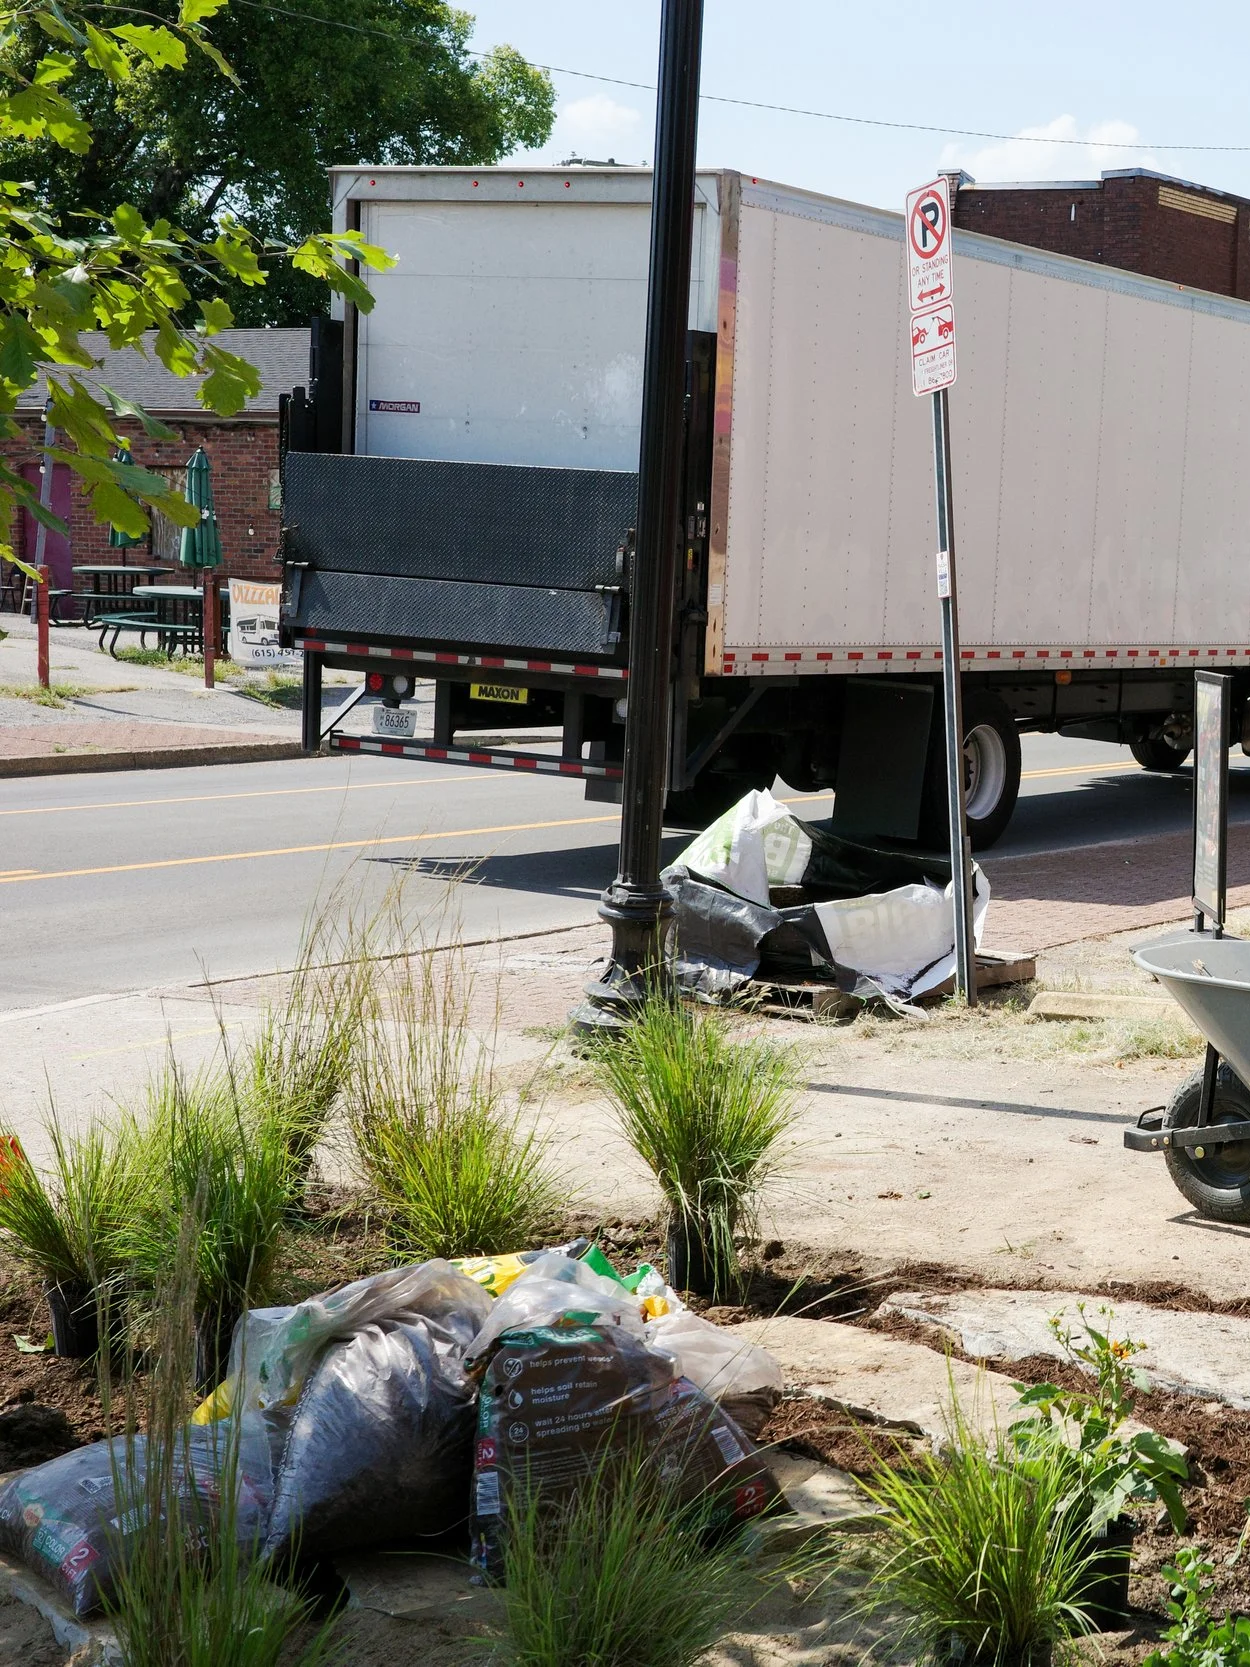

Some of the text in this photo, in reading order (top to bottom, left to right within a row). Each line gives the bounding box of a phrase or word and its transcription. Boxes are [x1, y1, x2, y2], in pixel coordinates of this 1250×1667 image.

[911, 254, 949, 277] OR STANDING
[917, 269, 945, 288] ANY TIME
[919, 349, 950, 366] CLAIM CAR
[378, 402, 419, 412] MORGAN
[251, 649, 275, 658] (615)
[478, 685, 520, 700] MAXON
[384, 714, 410, 729] 86365
[529, 1359, 553, 1369] helps
[554, 1355, 586, 1367] prevent
[530, 1381, 598, 1396] helps soil retain
[532, 1393, 570, 1404] moisture
[535, 1418, 553, 1427] wait
[555, 1415, 566, 1423] 24
[567, 1411, 591, 1421] hours
[514, 1427, 524, 1435] 24
[536, 1423, 580, 1438] spreading
[592, 1416, 614, 1426] water
[482, 1447, 494, 1460] 2
[45, 1535, 66, 1556] COLOR
[69, 1547, 90, 1567] 2
